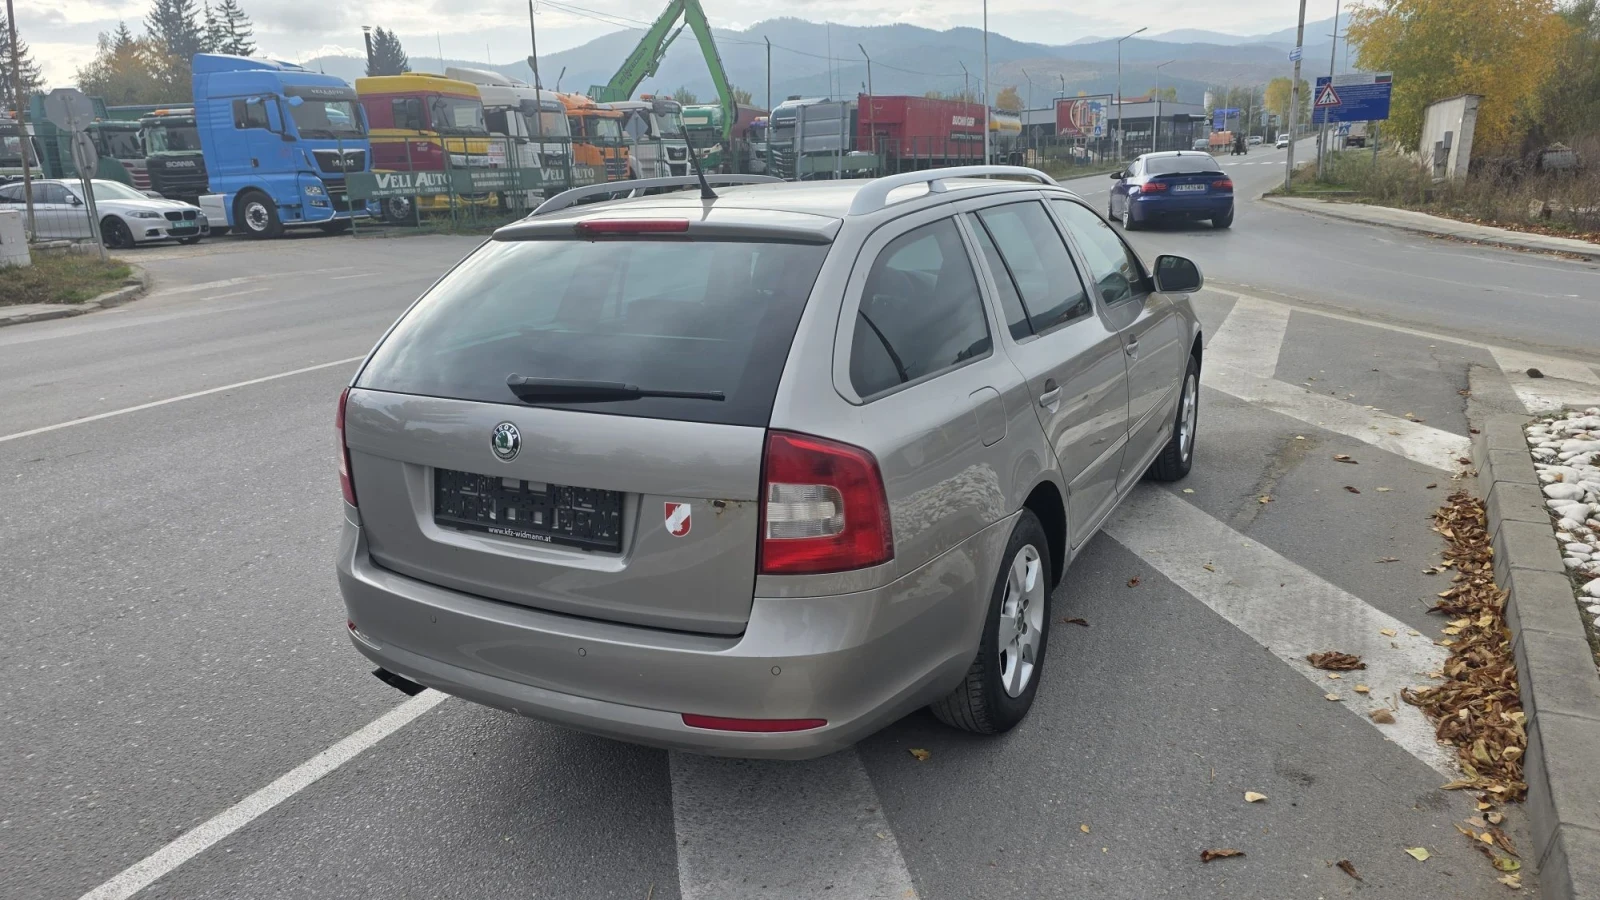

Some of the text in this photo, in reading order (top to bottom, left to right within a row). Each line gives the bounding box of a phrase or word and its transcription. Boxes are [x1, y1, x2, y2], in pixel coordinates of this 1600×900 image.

[165, 160, 195, 168] SCANIA
[332, 159, 354, 167] MAN
[375, 172, 452, 189] VELI AUTO
[540, 168, 564, 181] VELI
[488, 527, 551, 542] www.kfz-widmann.at
